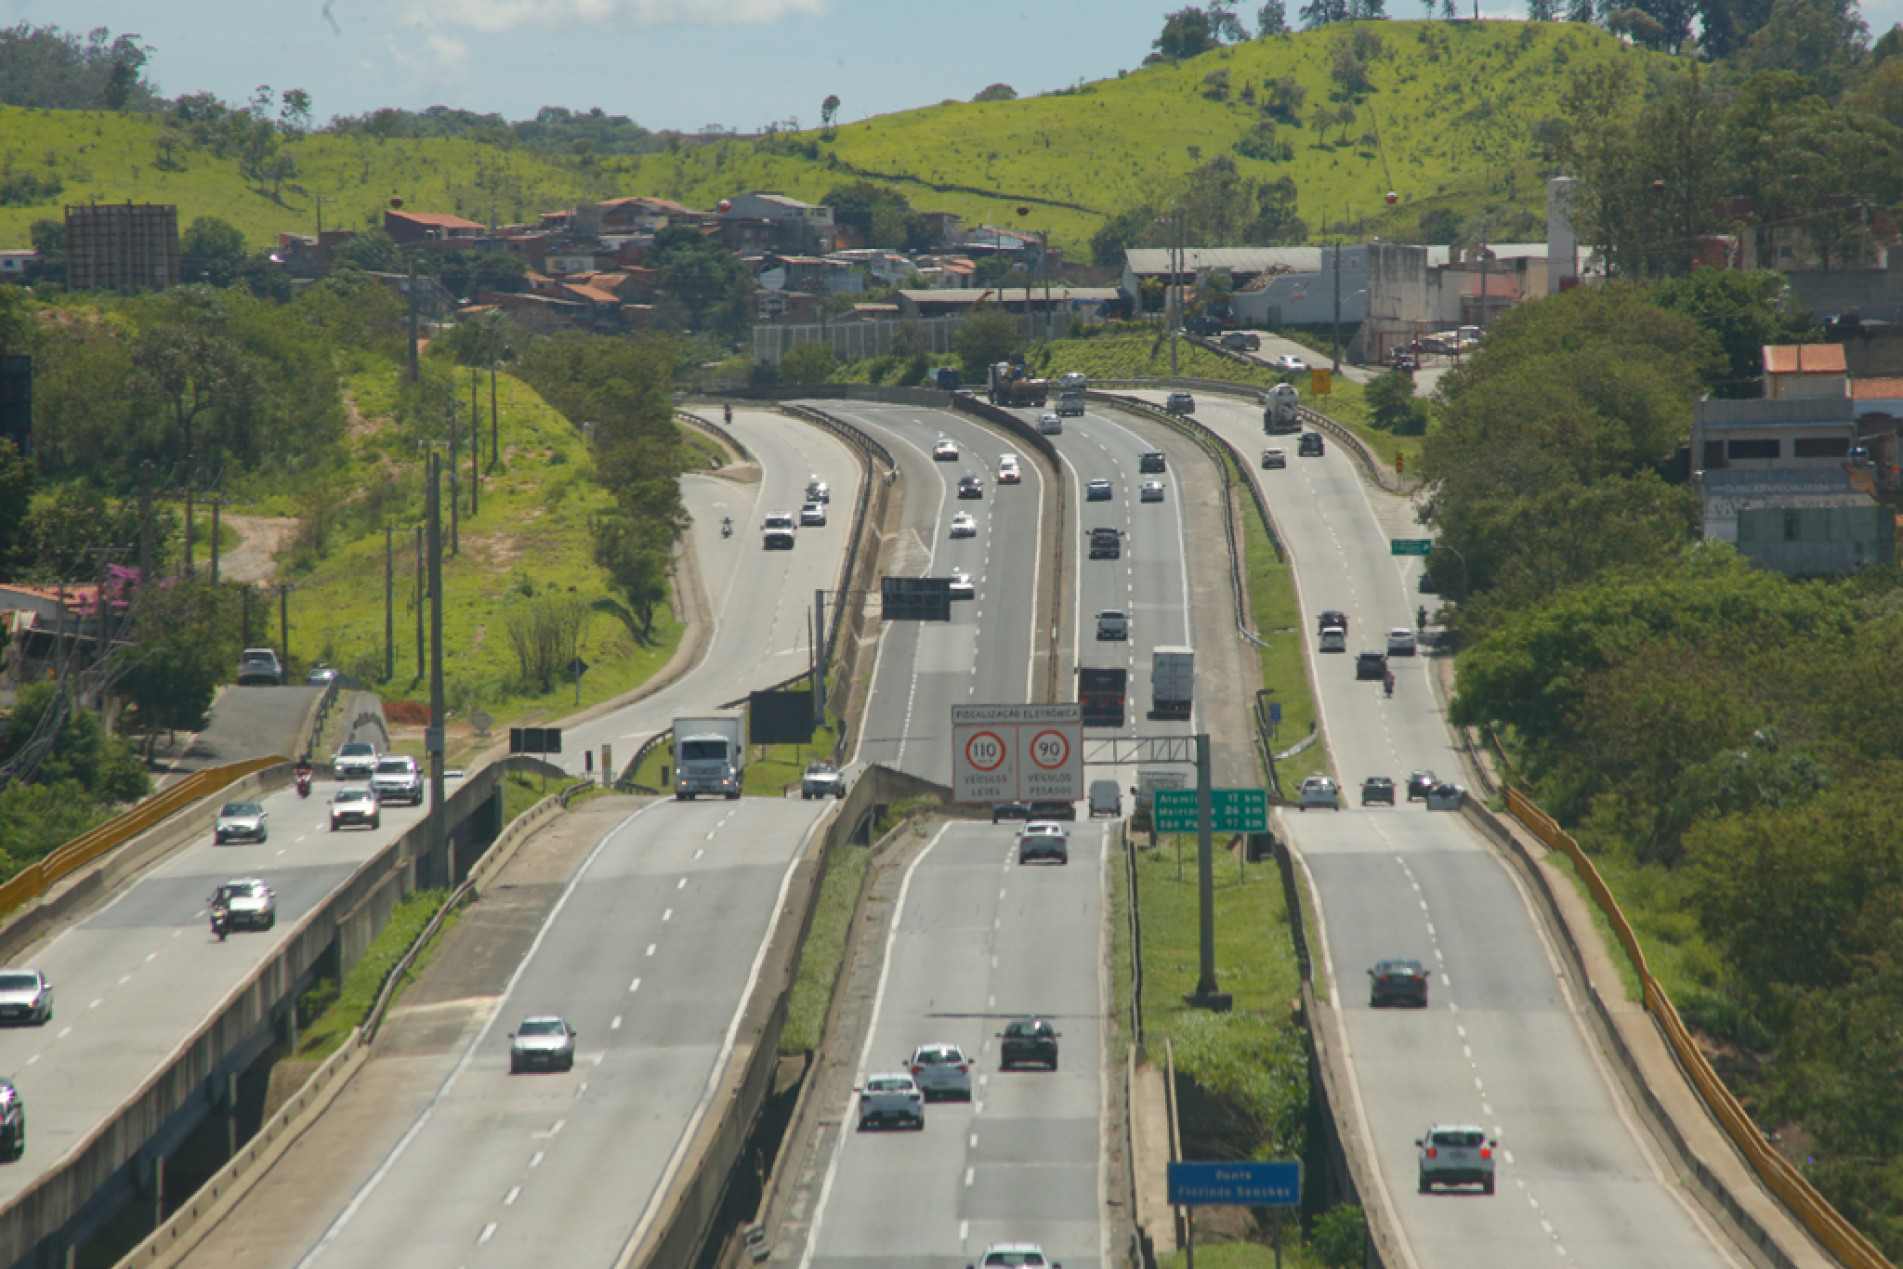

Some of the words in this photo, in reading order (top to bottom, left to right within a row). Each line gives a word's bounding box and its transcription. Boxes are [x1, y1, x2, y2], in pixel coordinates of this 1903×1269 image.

[973, 742, 997, 757] 110
[1039, 742, 1060, 757] 90
[1244, 793, 1262, 803] km
[1244, 806, 1263, 816] km
[1244, 818, 1263, 828] km
